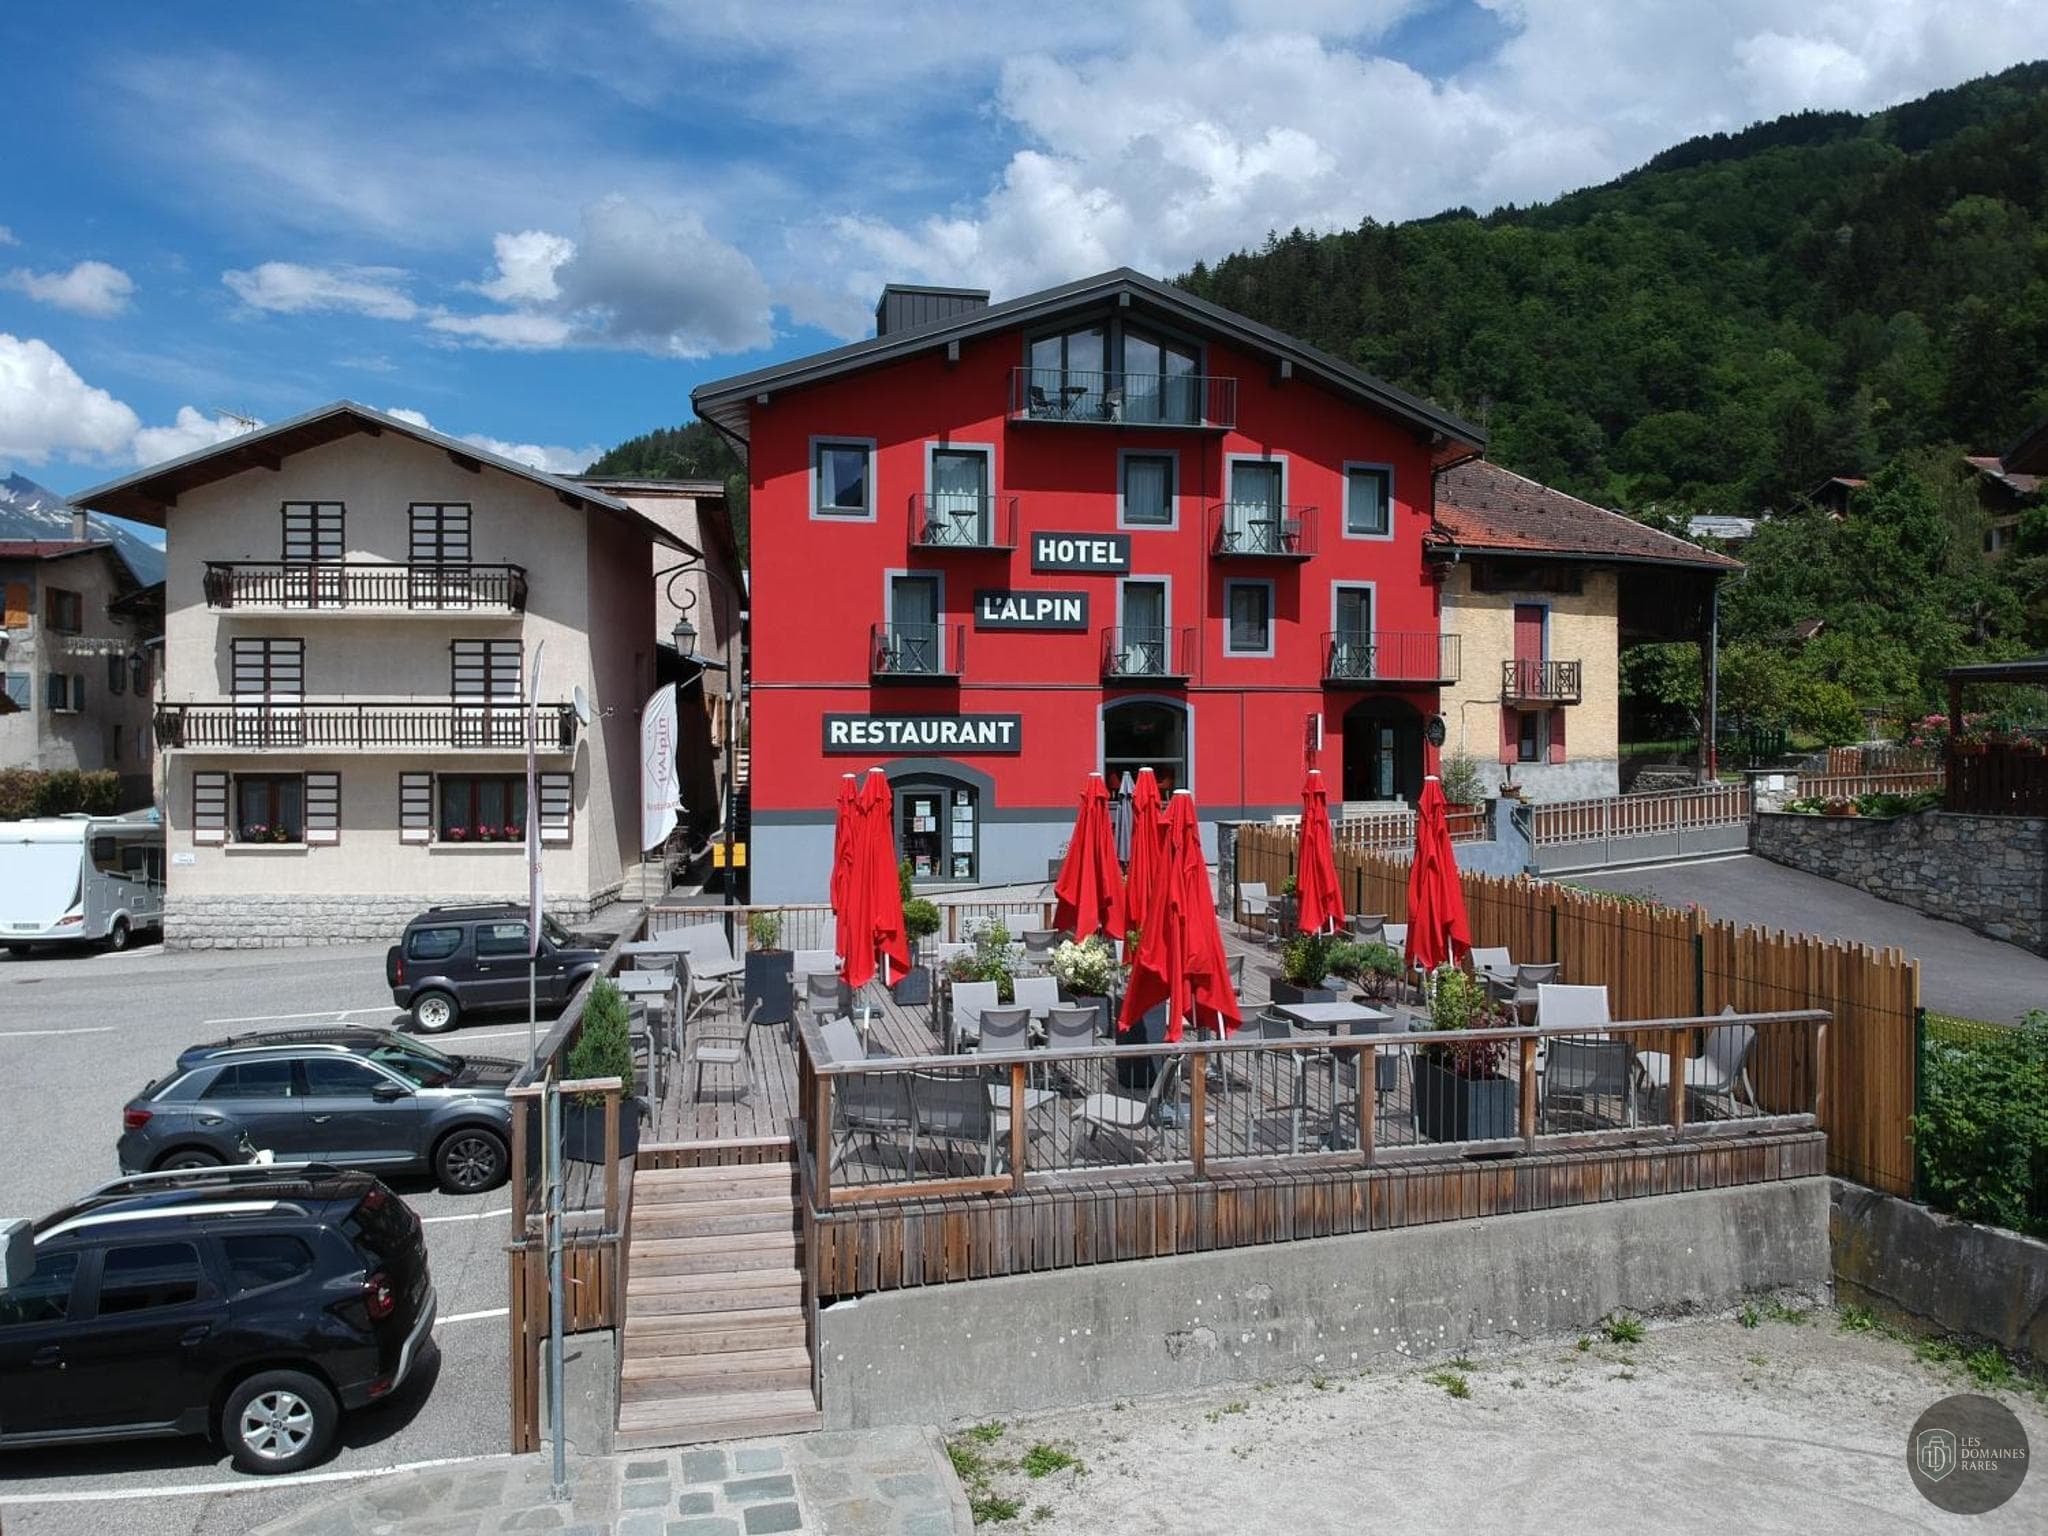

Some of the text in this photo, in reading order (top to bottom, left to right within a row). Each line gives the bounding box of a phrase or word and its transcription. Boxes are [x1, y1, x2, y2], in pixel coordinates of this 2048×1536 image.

[1038, 539, 1124, 563] HOTEL
[983, 597, 1081, 621] L'ALPIN
[830, 721, 1014, 744] RESTAURANT
